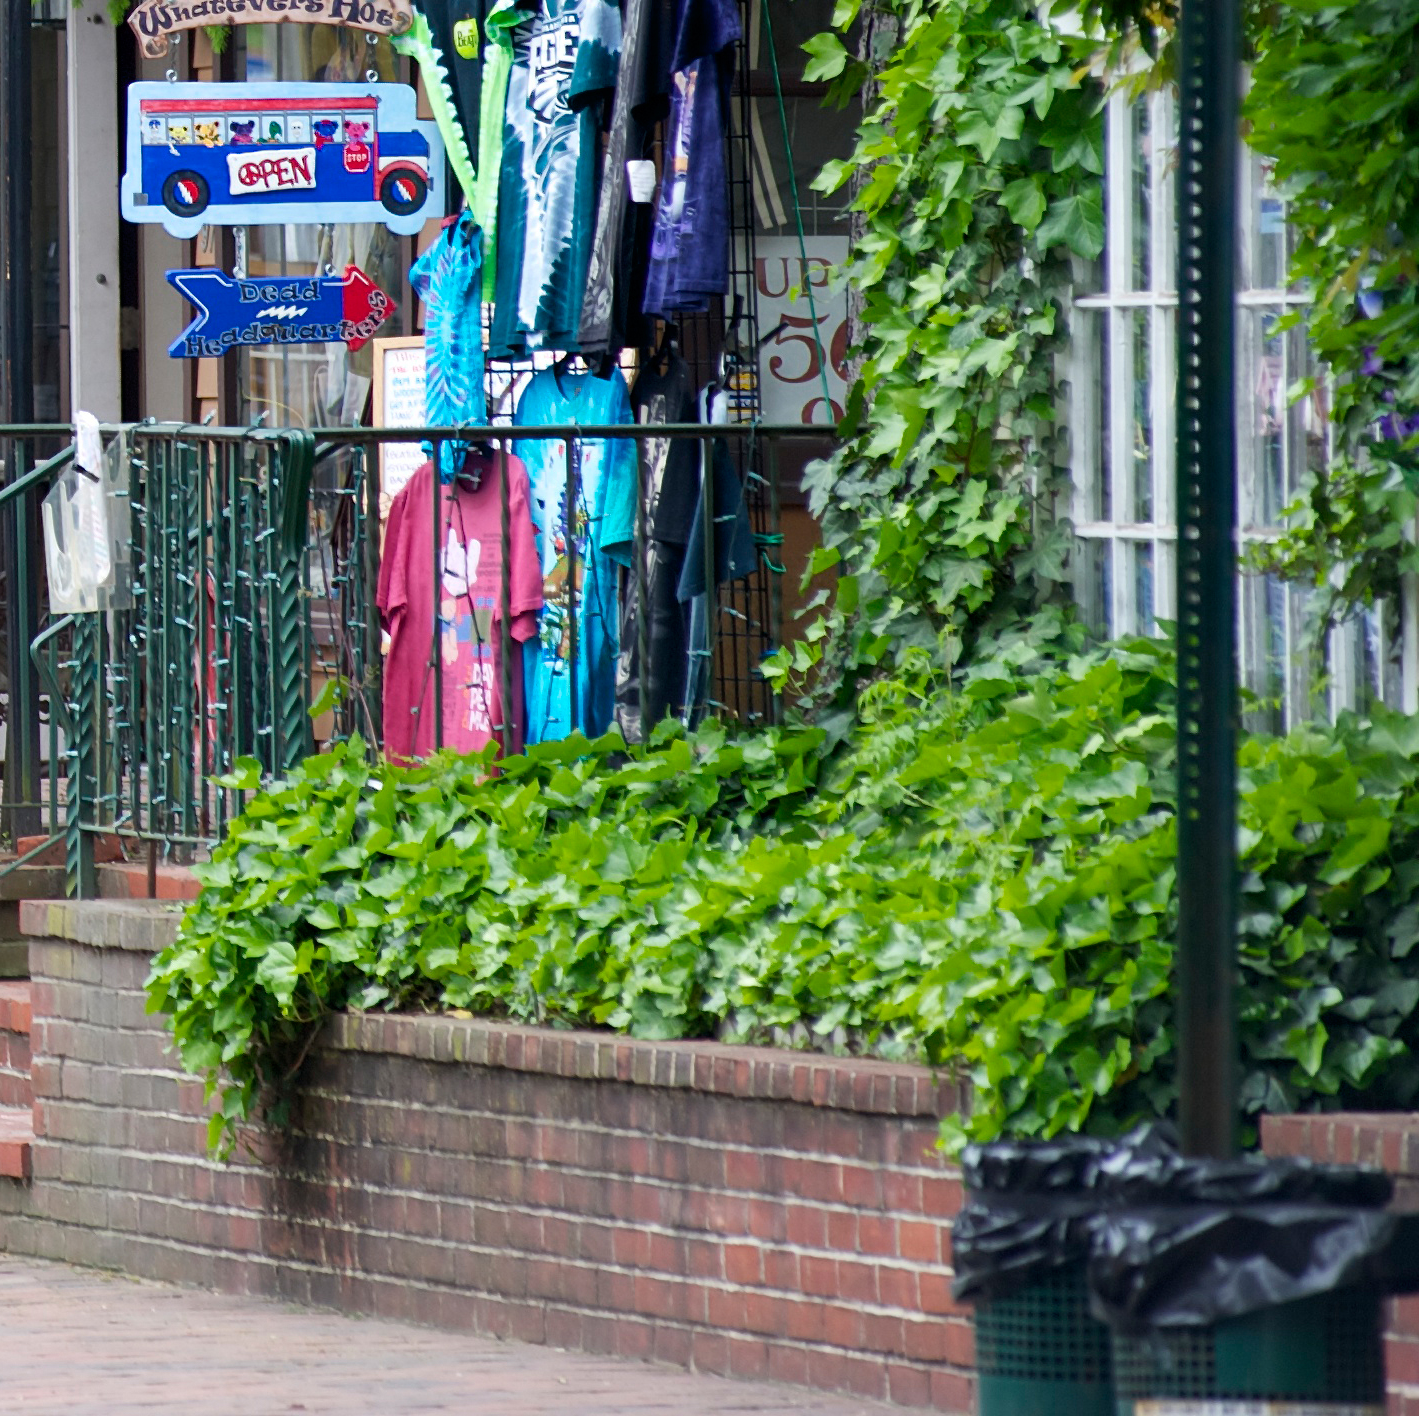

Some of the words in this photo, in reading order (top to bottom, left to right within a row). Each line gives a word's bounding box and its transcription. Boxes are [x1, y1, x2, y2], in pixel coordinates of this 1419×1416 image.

[347, 152, 368, 163] STOP
[238, 280, 322, 303] Dead
[755, 257, 833, 299] UP
[184, 289, 389, 357] Headquarters
